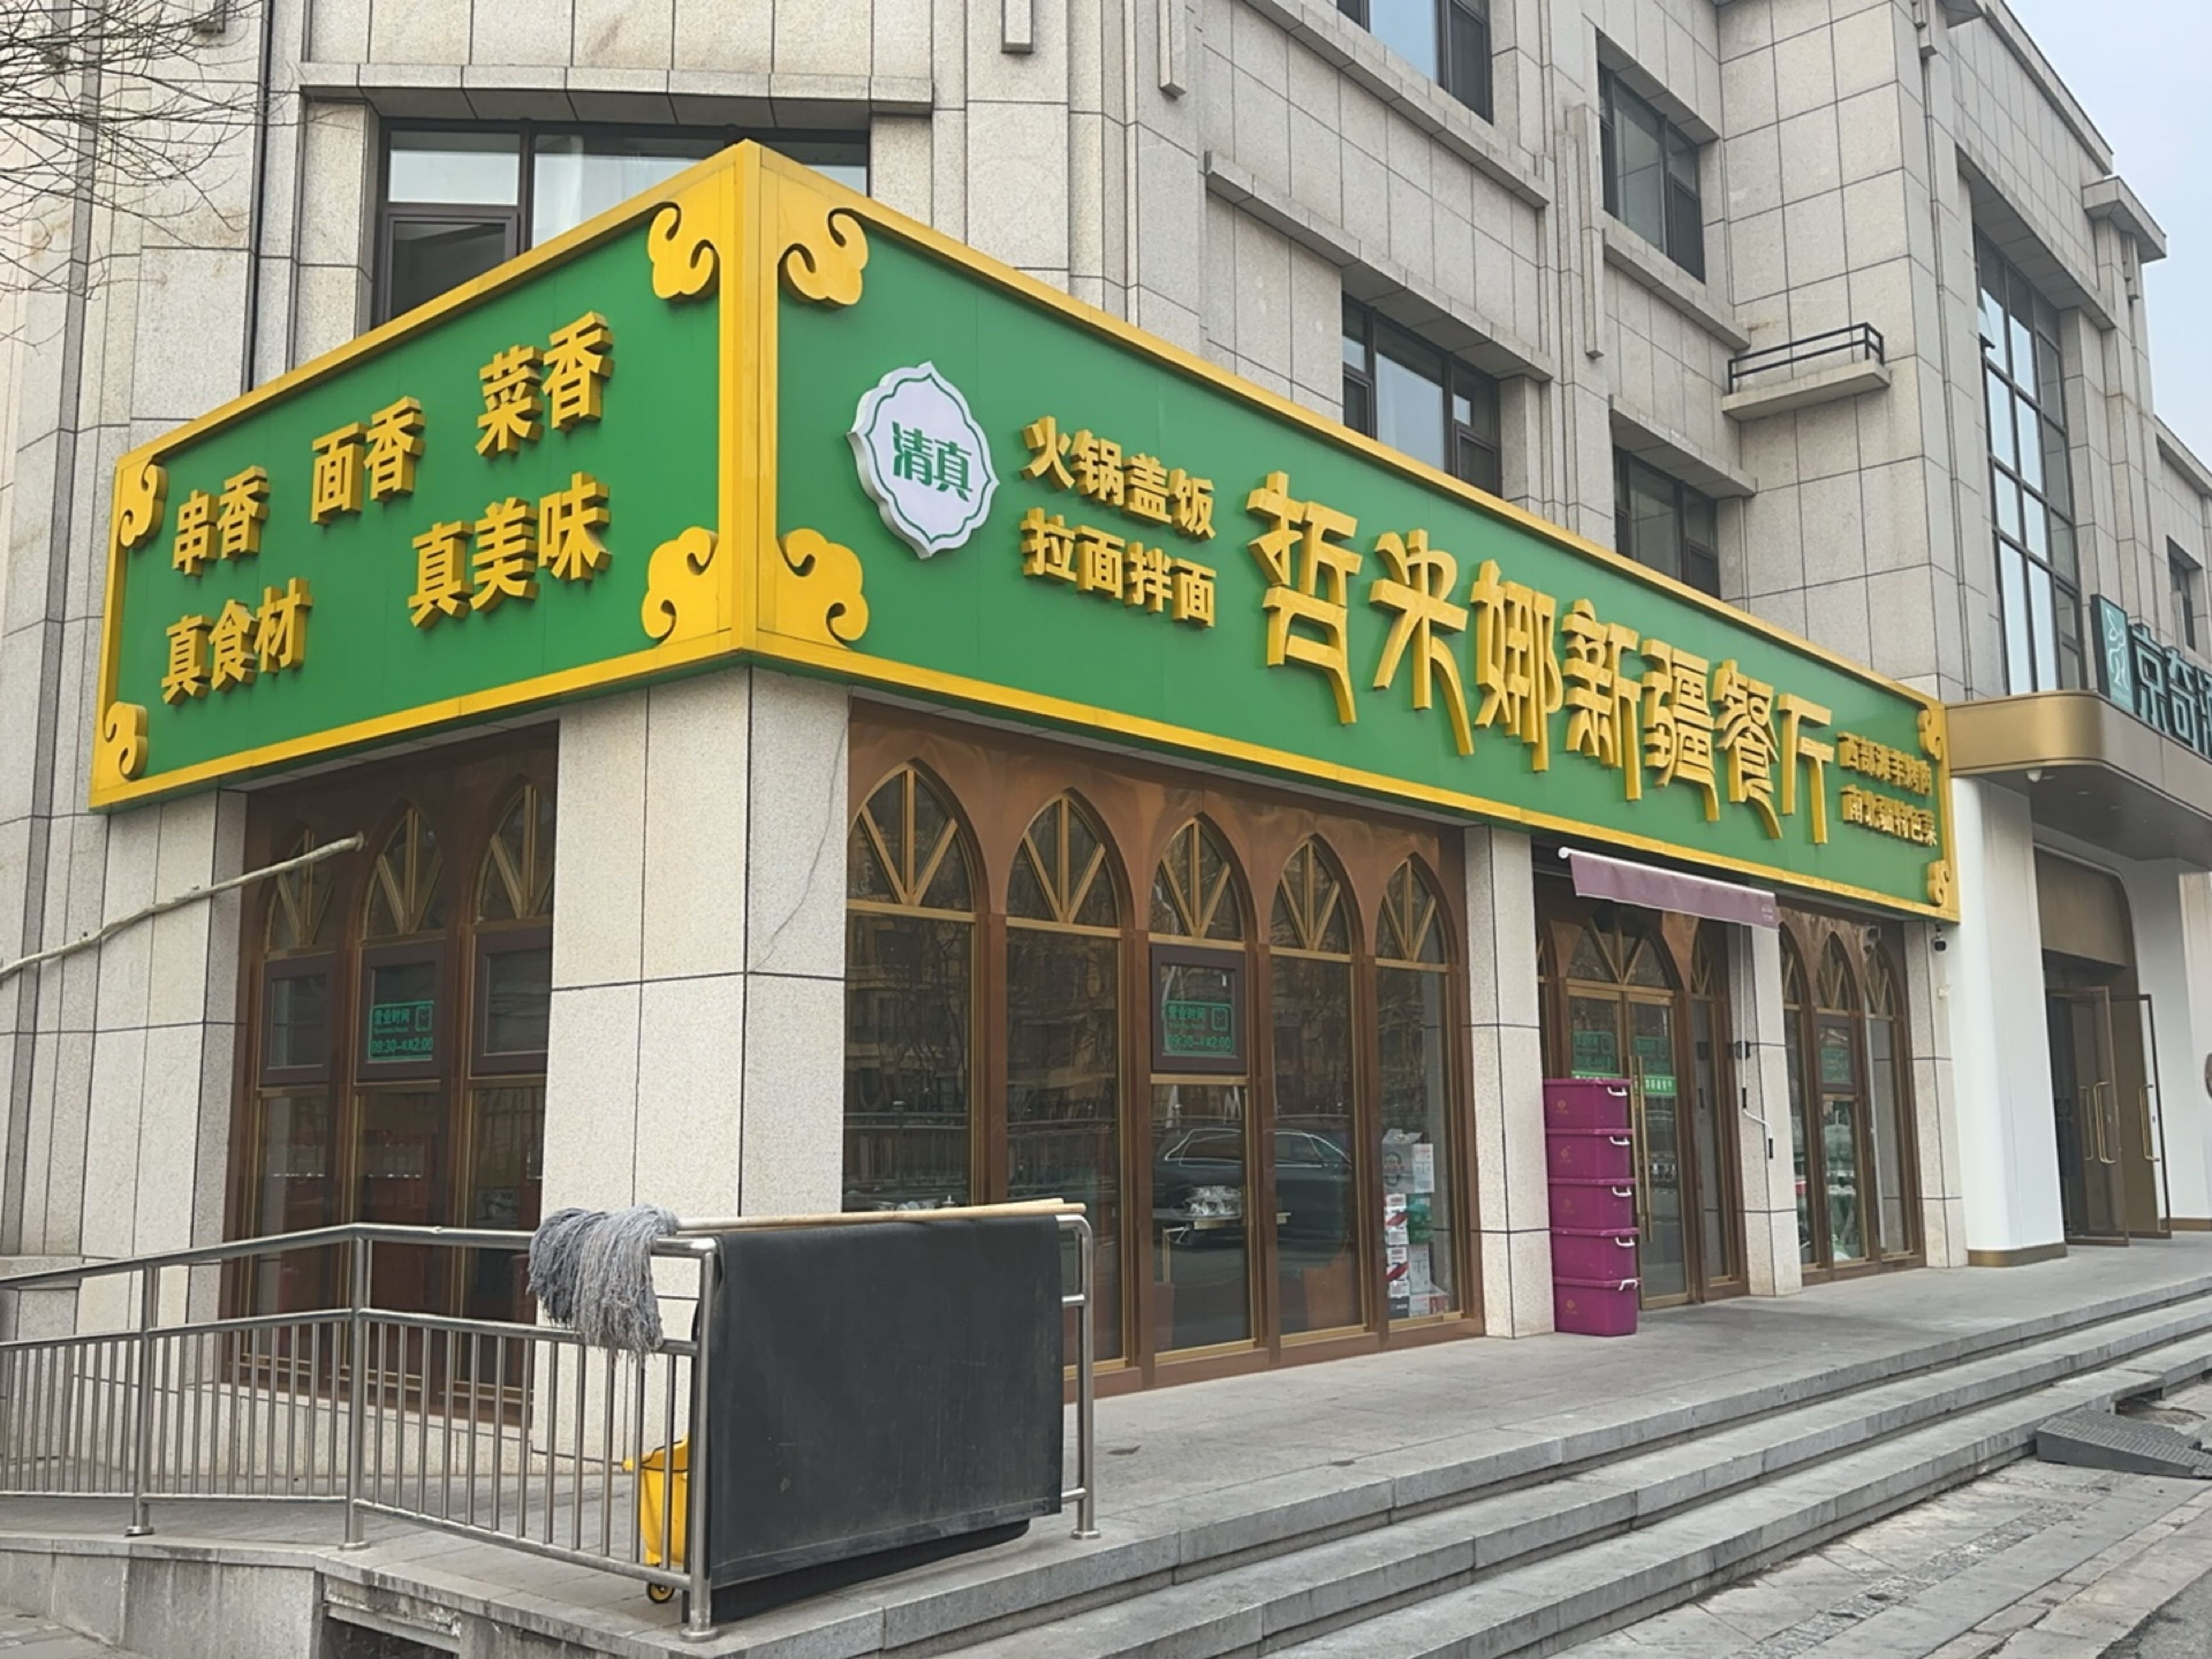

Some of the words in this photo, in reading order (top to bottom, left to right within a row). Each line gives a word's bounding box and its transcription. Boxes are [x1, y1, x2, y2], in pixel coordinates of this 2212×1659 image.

[172, 465, 269, 576] 串香
[310, 396, 426, 524] 面香
[475, 310, 614, 459] 菜香
[892, 421, 972, 502] 清真
[1021, 415, 1215, 540] 火锅盖饭
[161, 577, 313, 705] 真食材
[409, 471, 613, 629] 真美味
[1020, 507, 1215, 627] 拉面拌面
